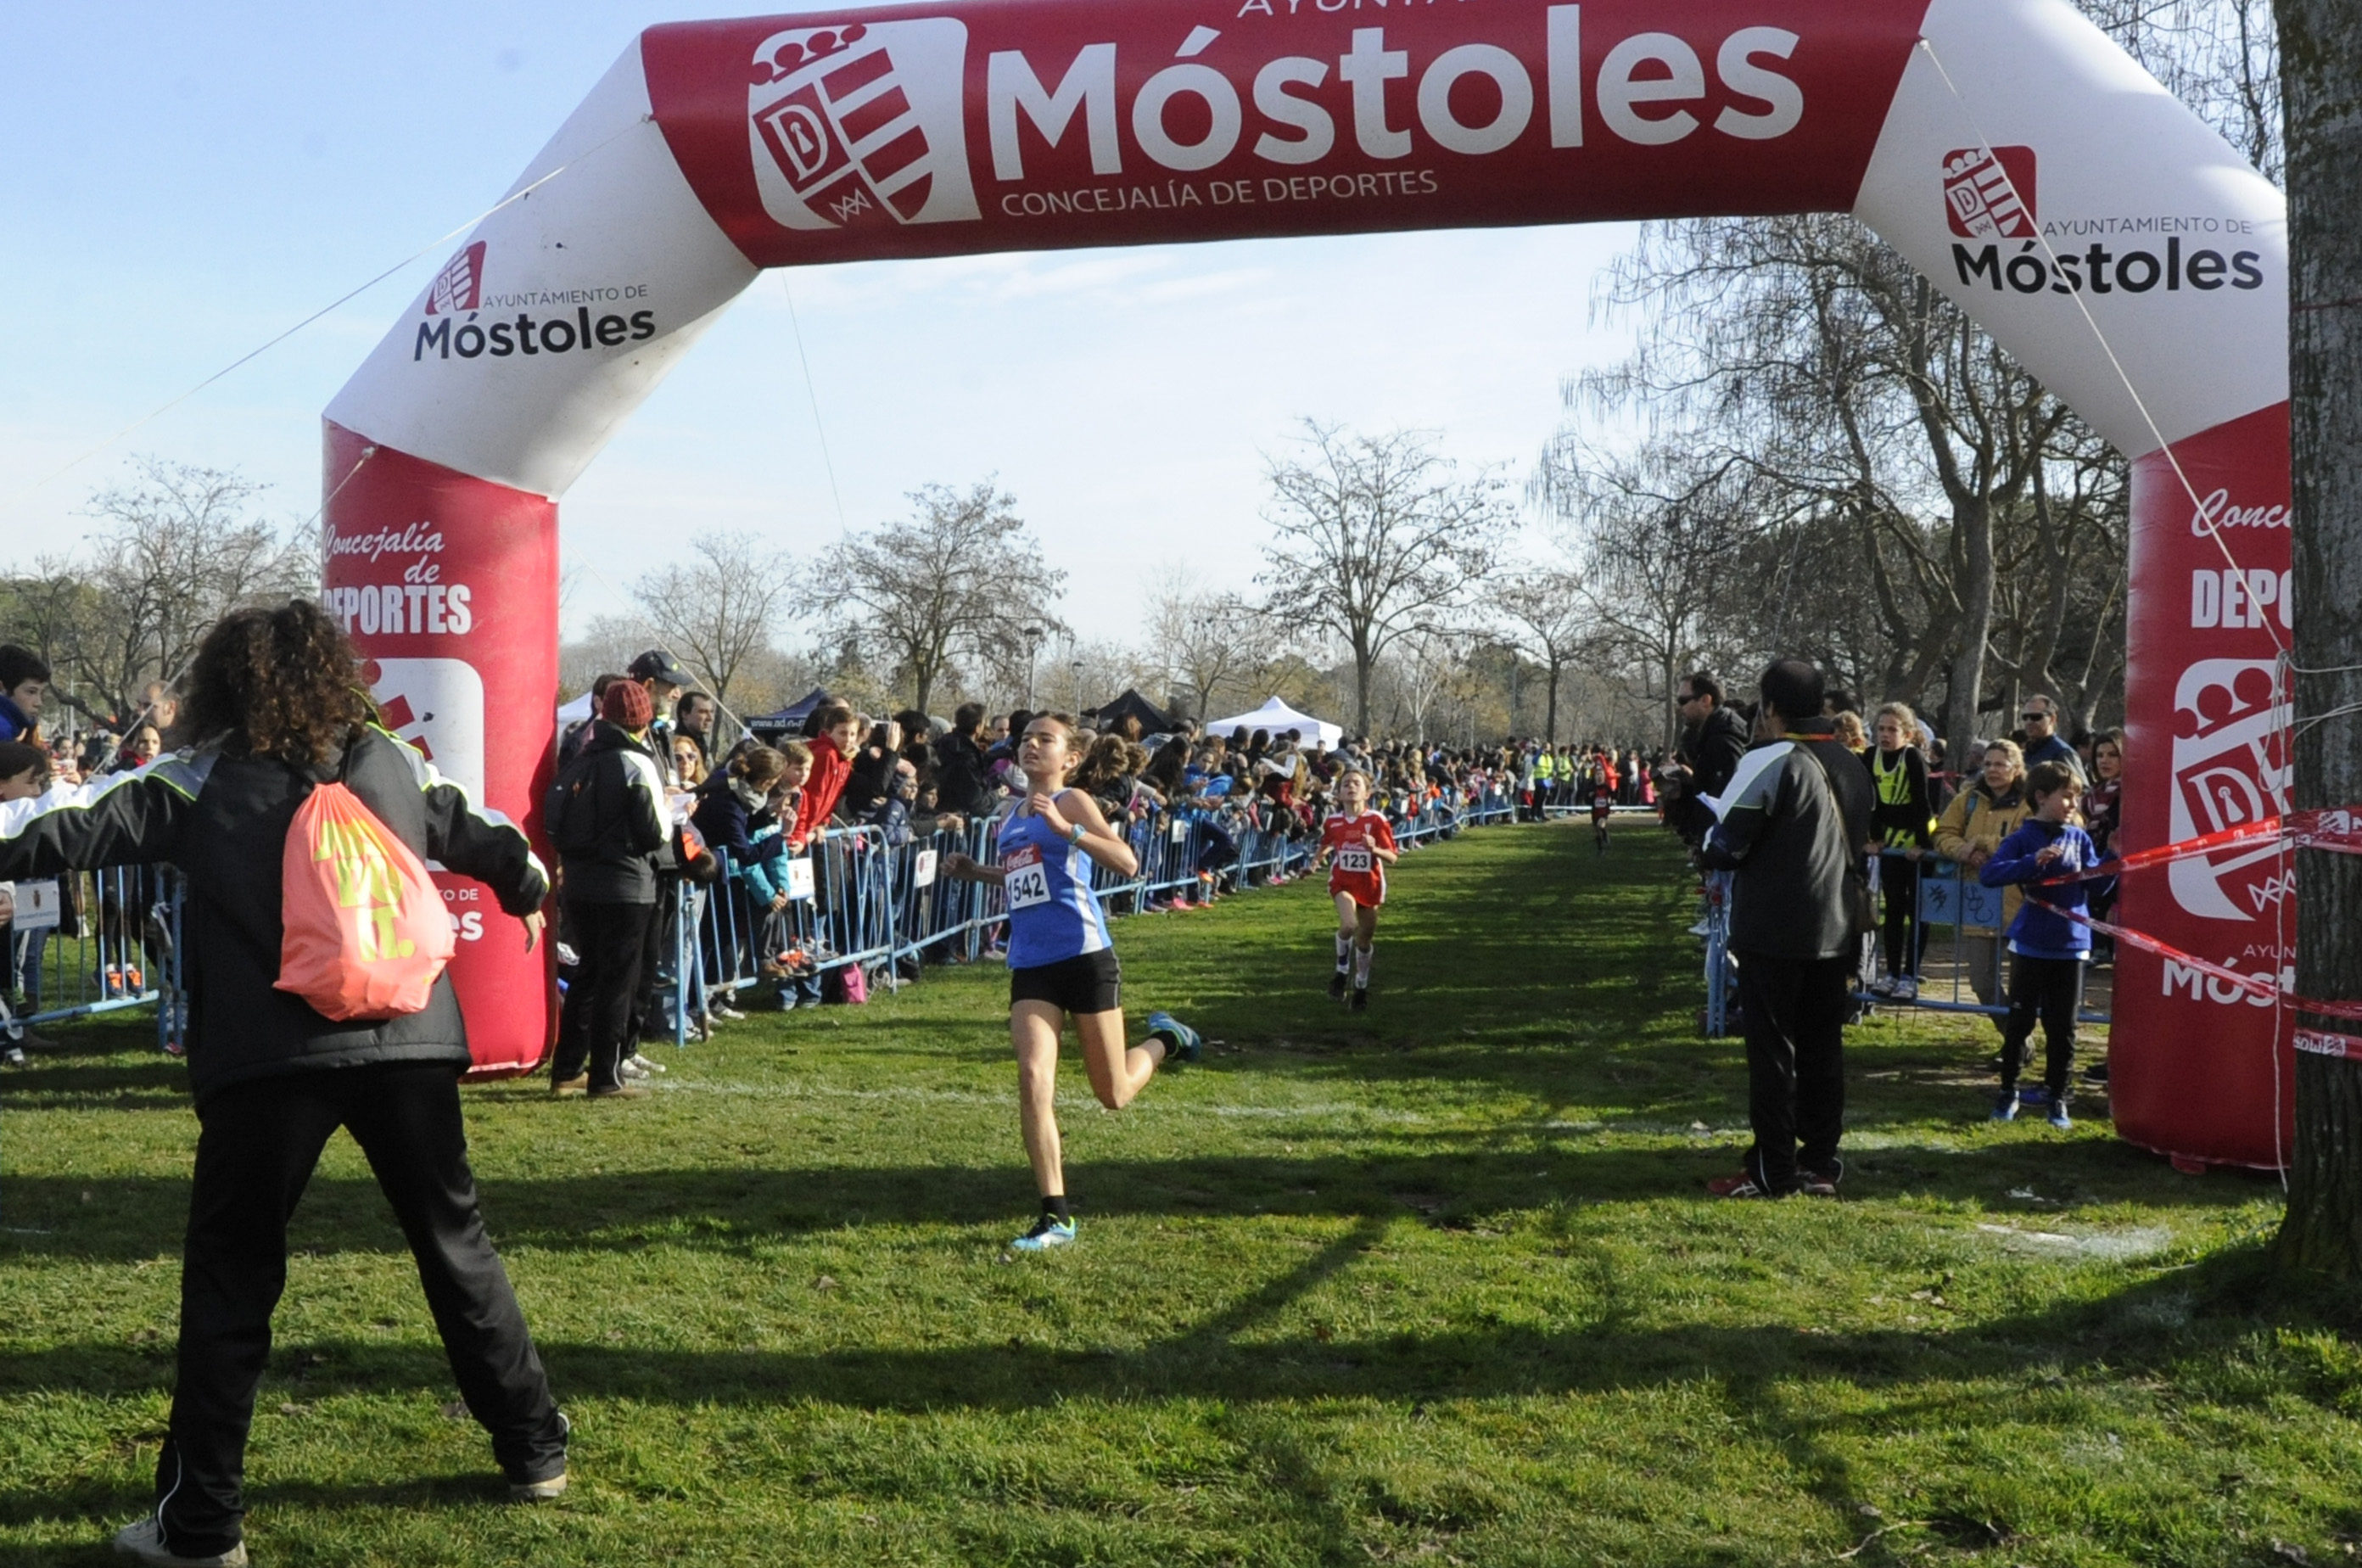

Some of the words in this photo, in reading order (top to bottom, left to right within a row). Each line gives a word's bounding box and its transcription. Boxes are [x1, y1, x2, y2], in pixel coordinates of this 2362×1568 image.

[988, 3, 1805, 182] Móstoles
[1000, 178, 1203, 217] CONCEJALÍA
[1209, 179, 1256, 206] DE
[1262, 170, 1439, 203] DEPORTES
[2042, 216, 2220, 238] AYUNTAMIENTO
[2225, 218, 2253, 235] DE
[1951, 236, 2264, 294] Móstoles
[483, 287, 620, 309] AYUNTAMIENTO
[624, 283, 649, 300] DE
[413, 306, 657, 361] Móstoles
[323, 520, 446, 564] Concejalía
[403, 554, 441, 585] de
[1342, 854, 1368, 869] 123
[459, 888, 479, 901] DE
[1008, 872, 1044, 903] 1542
